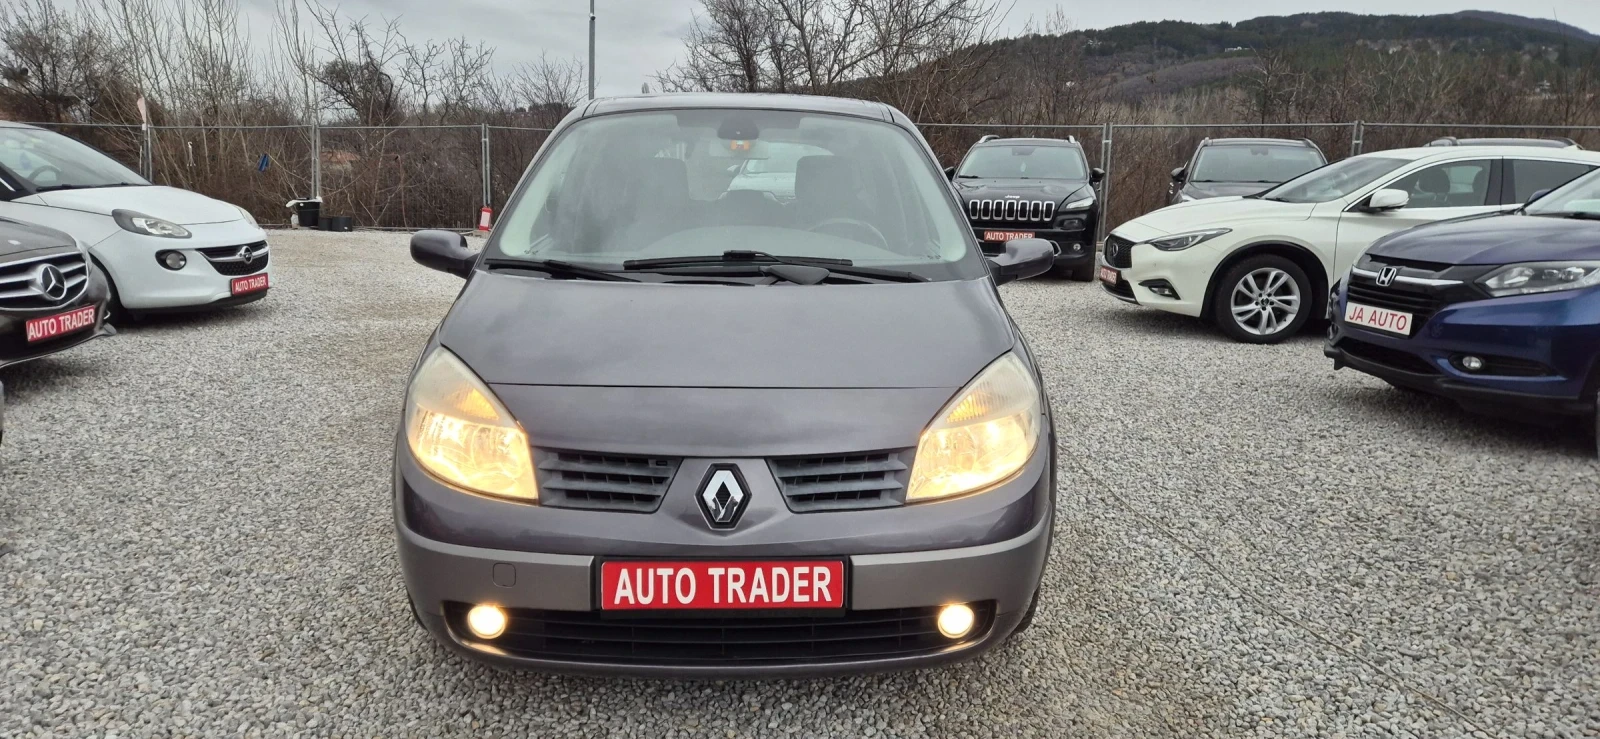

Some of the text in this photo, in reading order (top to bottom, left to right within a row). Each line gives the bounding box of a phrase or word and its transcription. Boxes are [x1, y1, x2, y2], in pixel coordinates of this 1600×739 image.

[986, 231, 1004, 241] AUTO
[235, 276, 267, 292] AUTO TRADER
[28, 308, 95, 341] AUTO TRADER
[1349, 306, 1407, 331] JA AUTO
[614, 566, 832, 605] AUTO TRADER
